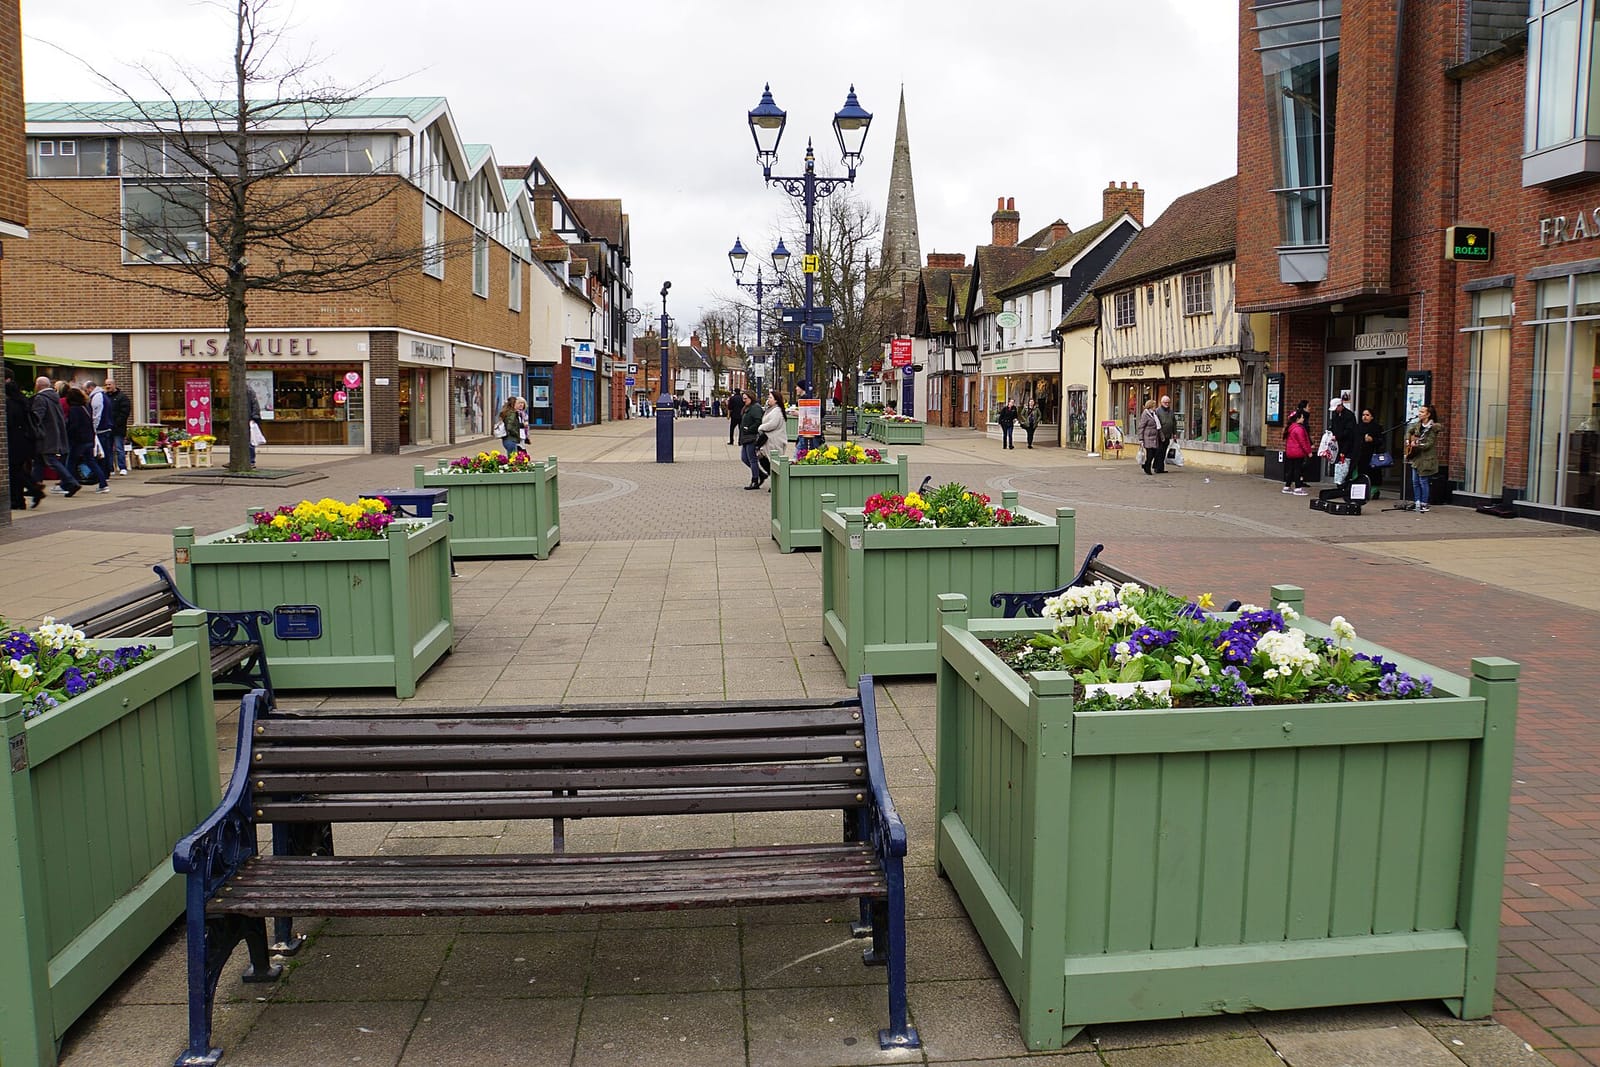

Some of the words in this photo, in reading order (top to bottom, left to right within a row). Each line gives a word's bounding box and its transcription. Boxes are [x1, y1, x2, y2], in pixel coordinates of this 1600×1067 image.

[1455, 246, 1487, 255] ROLEX
[805, 256, 816, 271] H
[1355, 332, 1408, 350] TOUCHWOOD
[1194, 363, 1213, 374] JOULES
